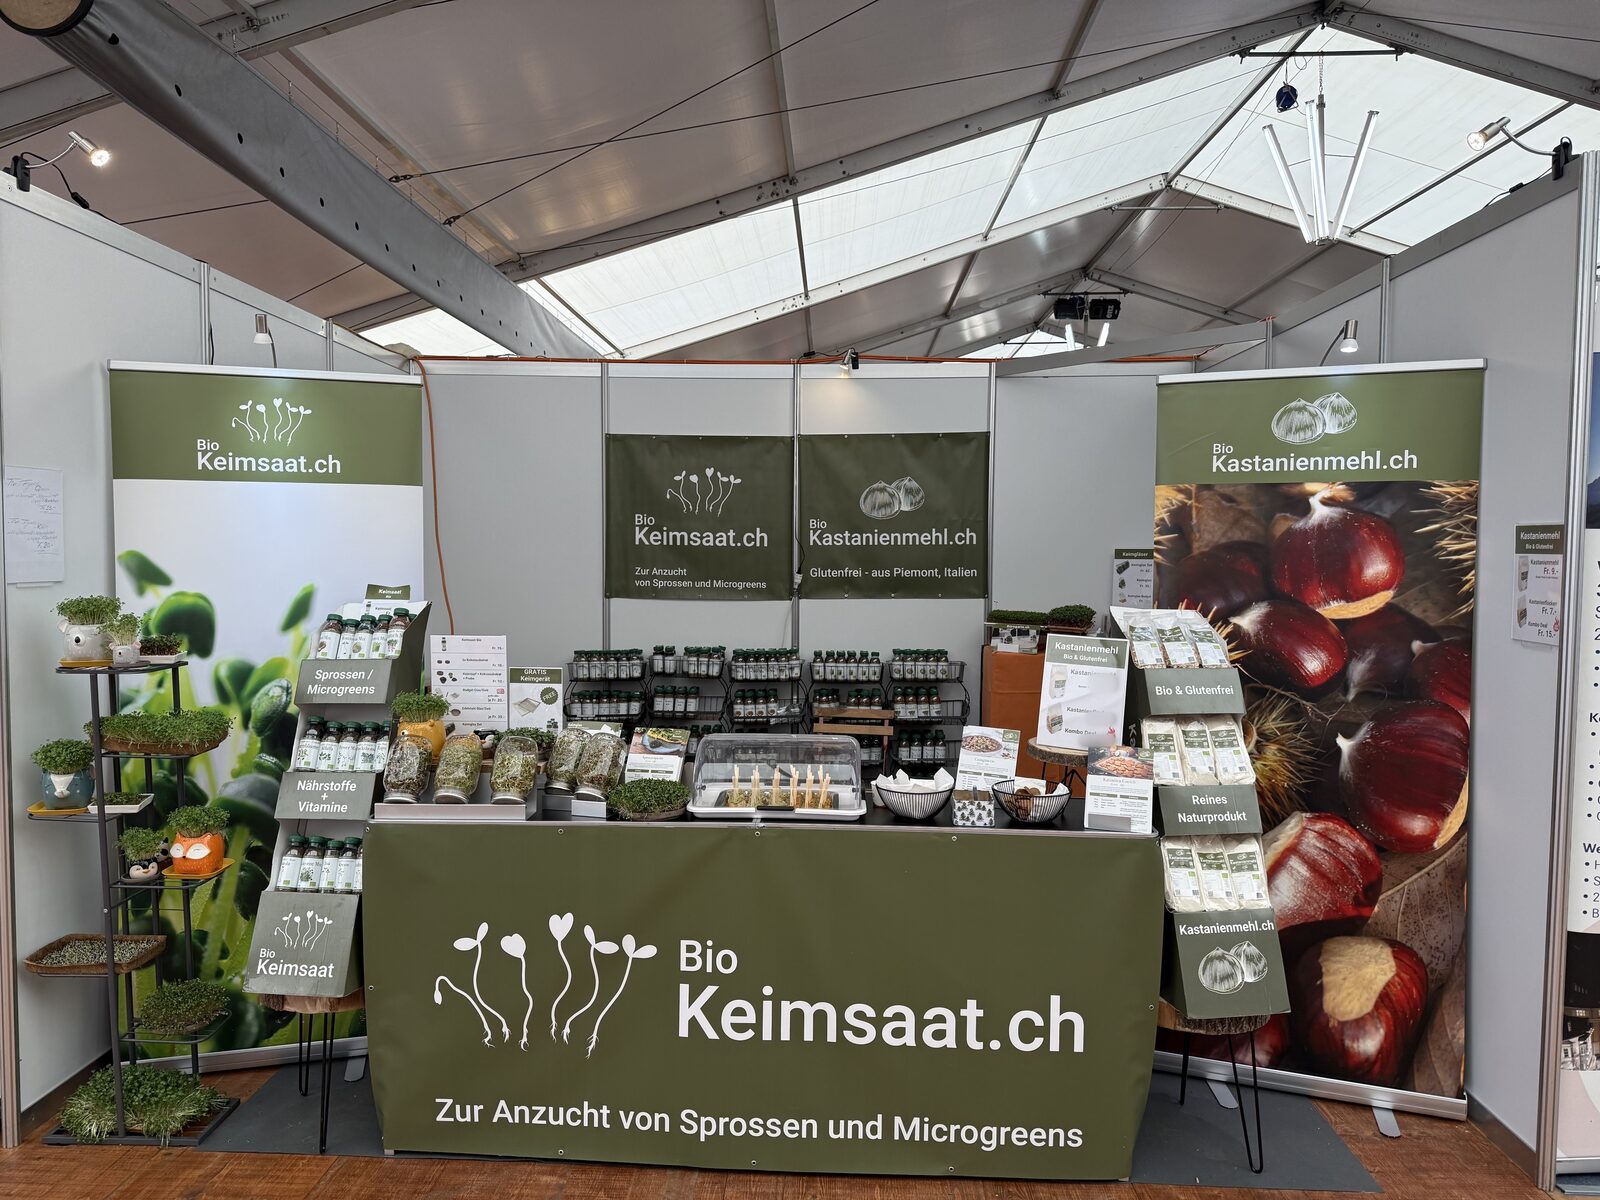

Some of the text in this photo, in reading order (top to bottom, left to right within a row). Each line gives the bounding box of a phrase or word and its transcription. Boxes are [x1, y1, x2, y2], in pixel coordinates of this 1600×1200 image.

[197, 439, 219, 451] Bio
[1213, 443, 1233, 454] Bio
[197, 451, 341, 474] Keimsaat.ch
[1212, 450, 1418, 473] Kastanienmehl.ch
[635, 514, 655, 526] Bio
[809, 519, 827, 529] Bio
[635, 526, 768, 548] Keimsaat.ch
[809, 528, 977, 546] Kastanienmehl.ch
[1520, 531, 1560, 540] Kastanienmehl
[635, 567, 687, 577] Zur Anzucht
[810, 567, 862, 578] Glutenfrei
[871, 570, 891, 578] aus
[893, 567, 942, 579] Piemont,
[944, 567, 977, 578] Italien
[635, 578, 767, 592] von Sprossen und Microgreens
[1537, 629, 1545, 637] Fr.
[1055, 642, 1119, 655] Kastanienmehl
[1080, 655, 1108, 663] Glutenfrei
[314, 669, 374, 681] Sprossen /
[307, 684, 375, 697] Microgreens
[542, 690, 557, 701] FREE
[1155, 685, 1234, 696] Bio & Glutenfrei
[1064, 727, 1083, 735] Kombo
[297, 780, 357, 792] Nährstoffe
[321, 793, 329, 801] +
[1191, 795, 1228, 805] Reines
[298, 801, 348, 813] Vitamine
[1177, 811, 1247, 824] Naturprodukt
[1179, 919, 1275, 936] Kastanienmehl.ch
[259, 948, 276, 958] Bio
[680, 940, 738, 975] Bio
[256, 959, 335, 978] Keimsaat
[679, 984, 1085, 1054] Keimsaat.ch
[435, 1098, 1084, 1152] Zur Anzucht von Sprossen und Microgreens
